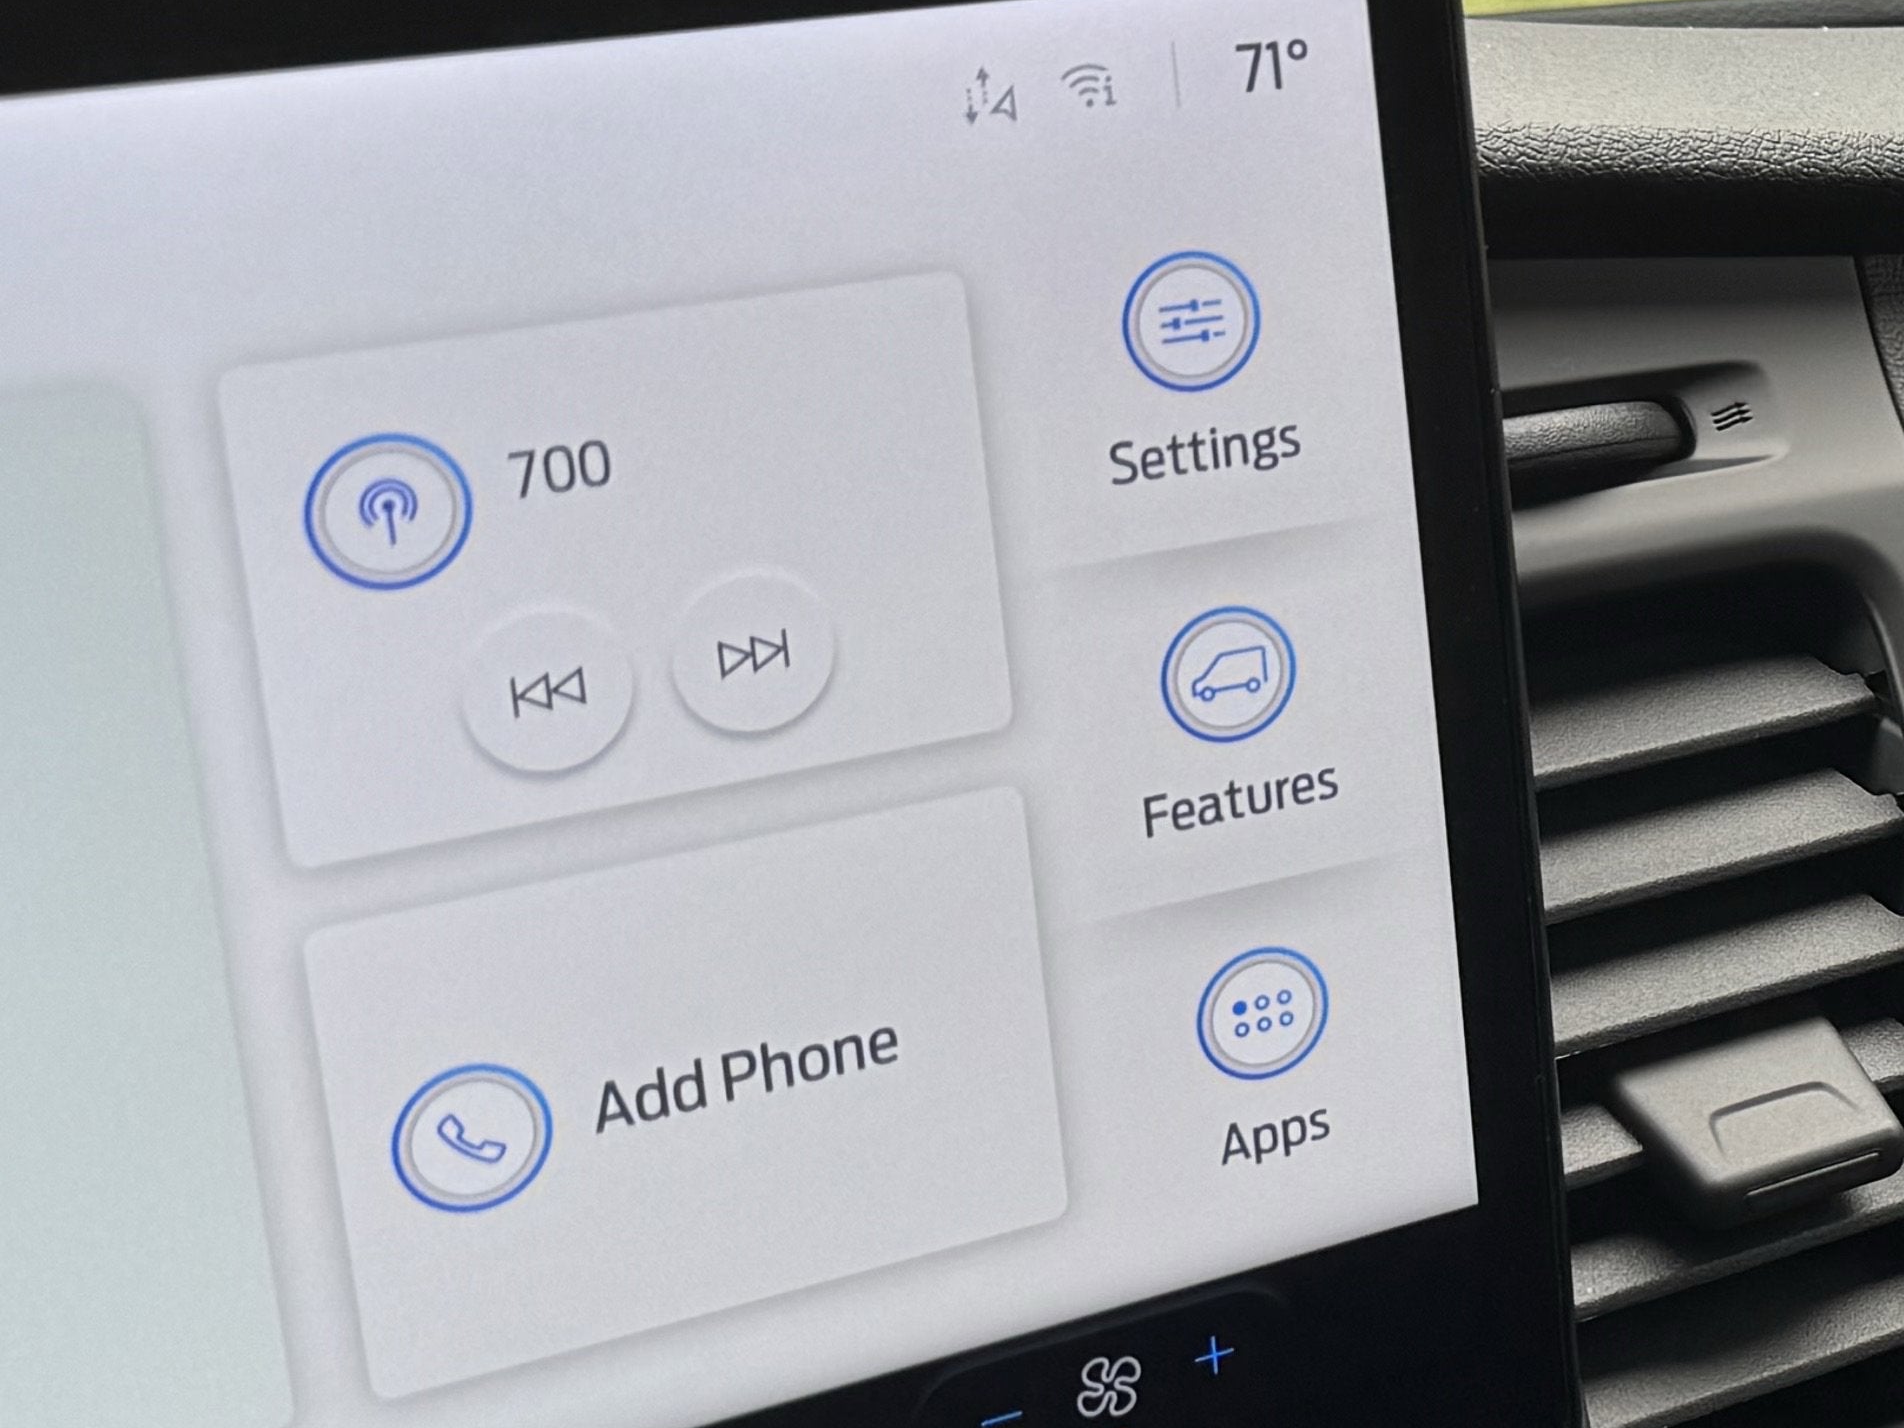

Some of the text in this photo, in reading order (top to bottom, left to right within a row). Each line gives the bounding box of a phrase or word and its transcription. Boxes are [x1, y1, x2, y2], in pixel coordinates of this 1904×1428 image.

[1235, 38, 1308, 93] 71°
[507, 440, 611, 499] 700
[1109, 422, 1301, 486] Settings
[1143, 766, 1338, 839] Features
[595, 1024, 899, 1134] Add Phone
[1220, 1105, 1331, 1167] Apps
